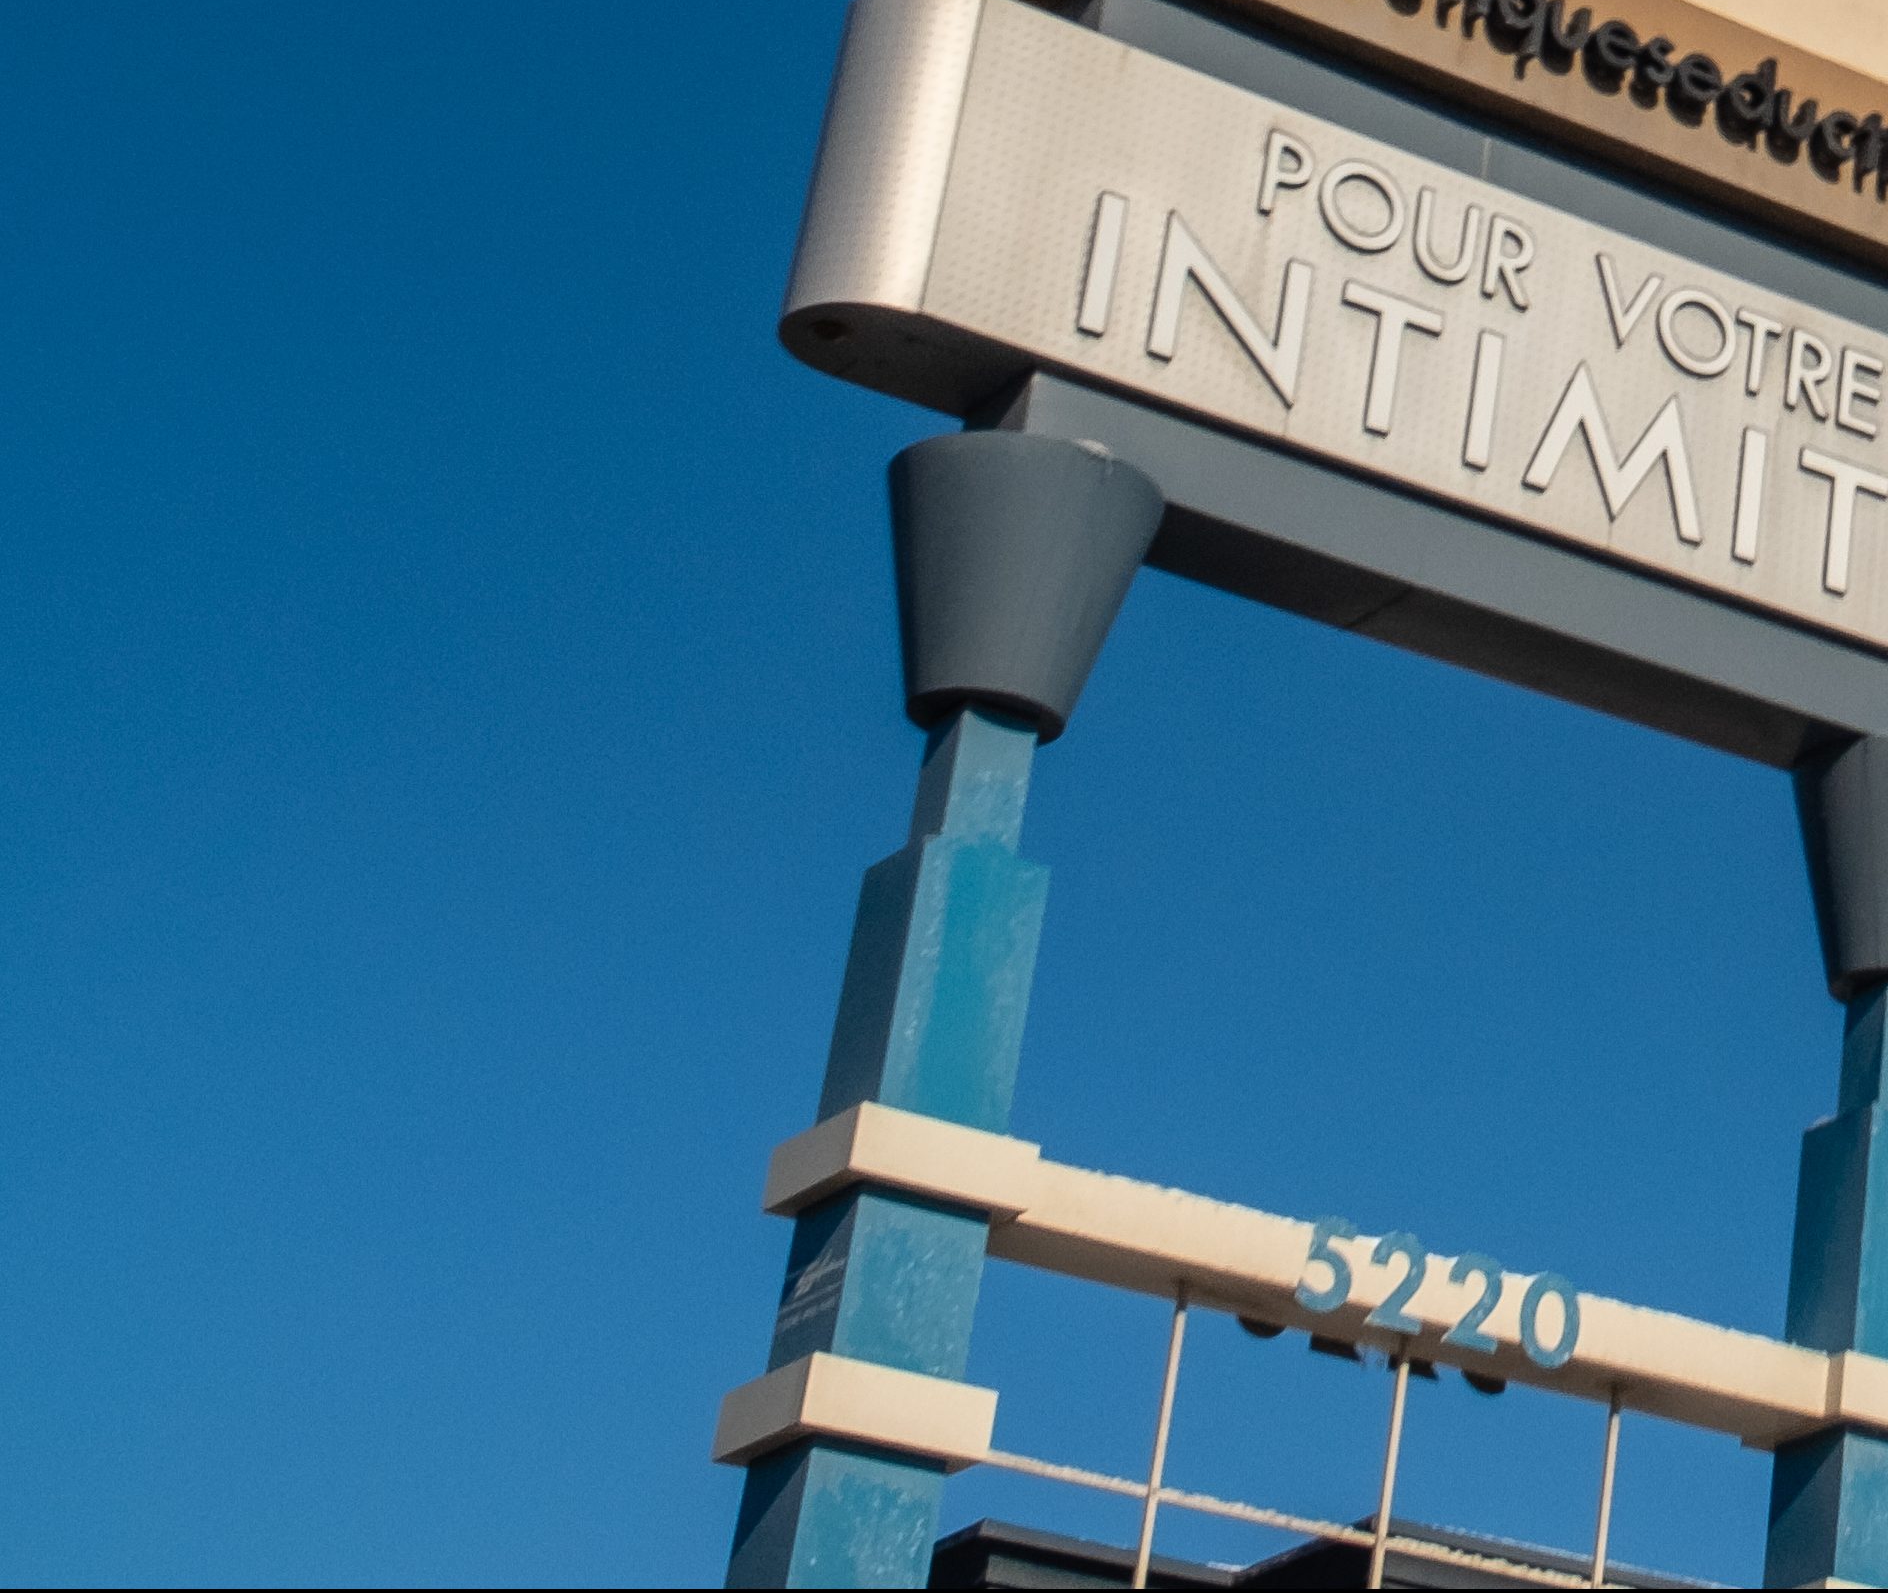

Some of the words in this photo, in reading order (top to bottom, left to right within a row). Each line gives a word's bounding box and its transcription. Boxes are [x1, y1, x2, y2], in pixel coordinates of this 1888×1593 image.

[1257, 128, 1537, 309] POUR
[1597, 253, 1885, 438] VOTRE
[1294, 1215, 1581, 1370] 5220
